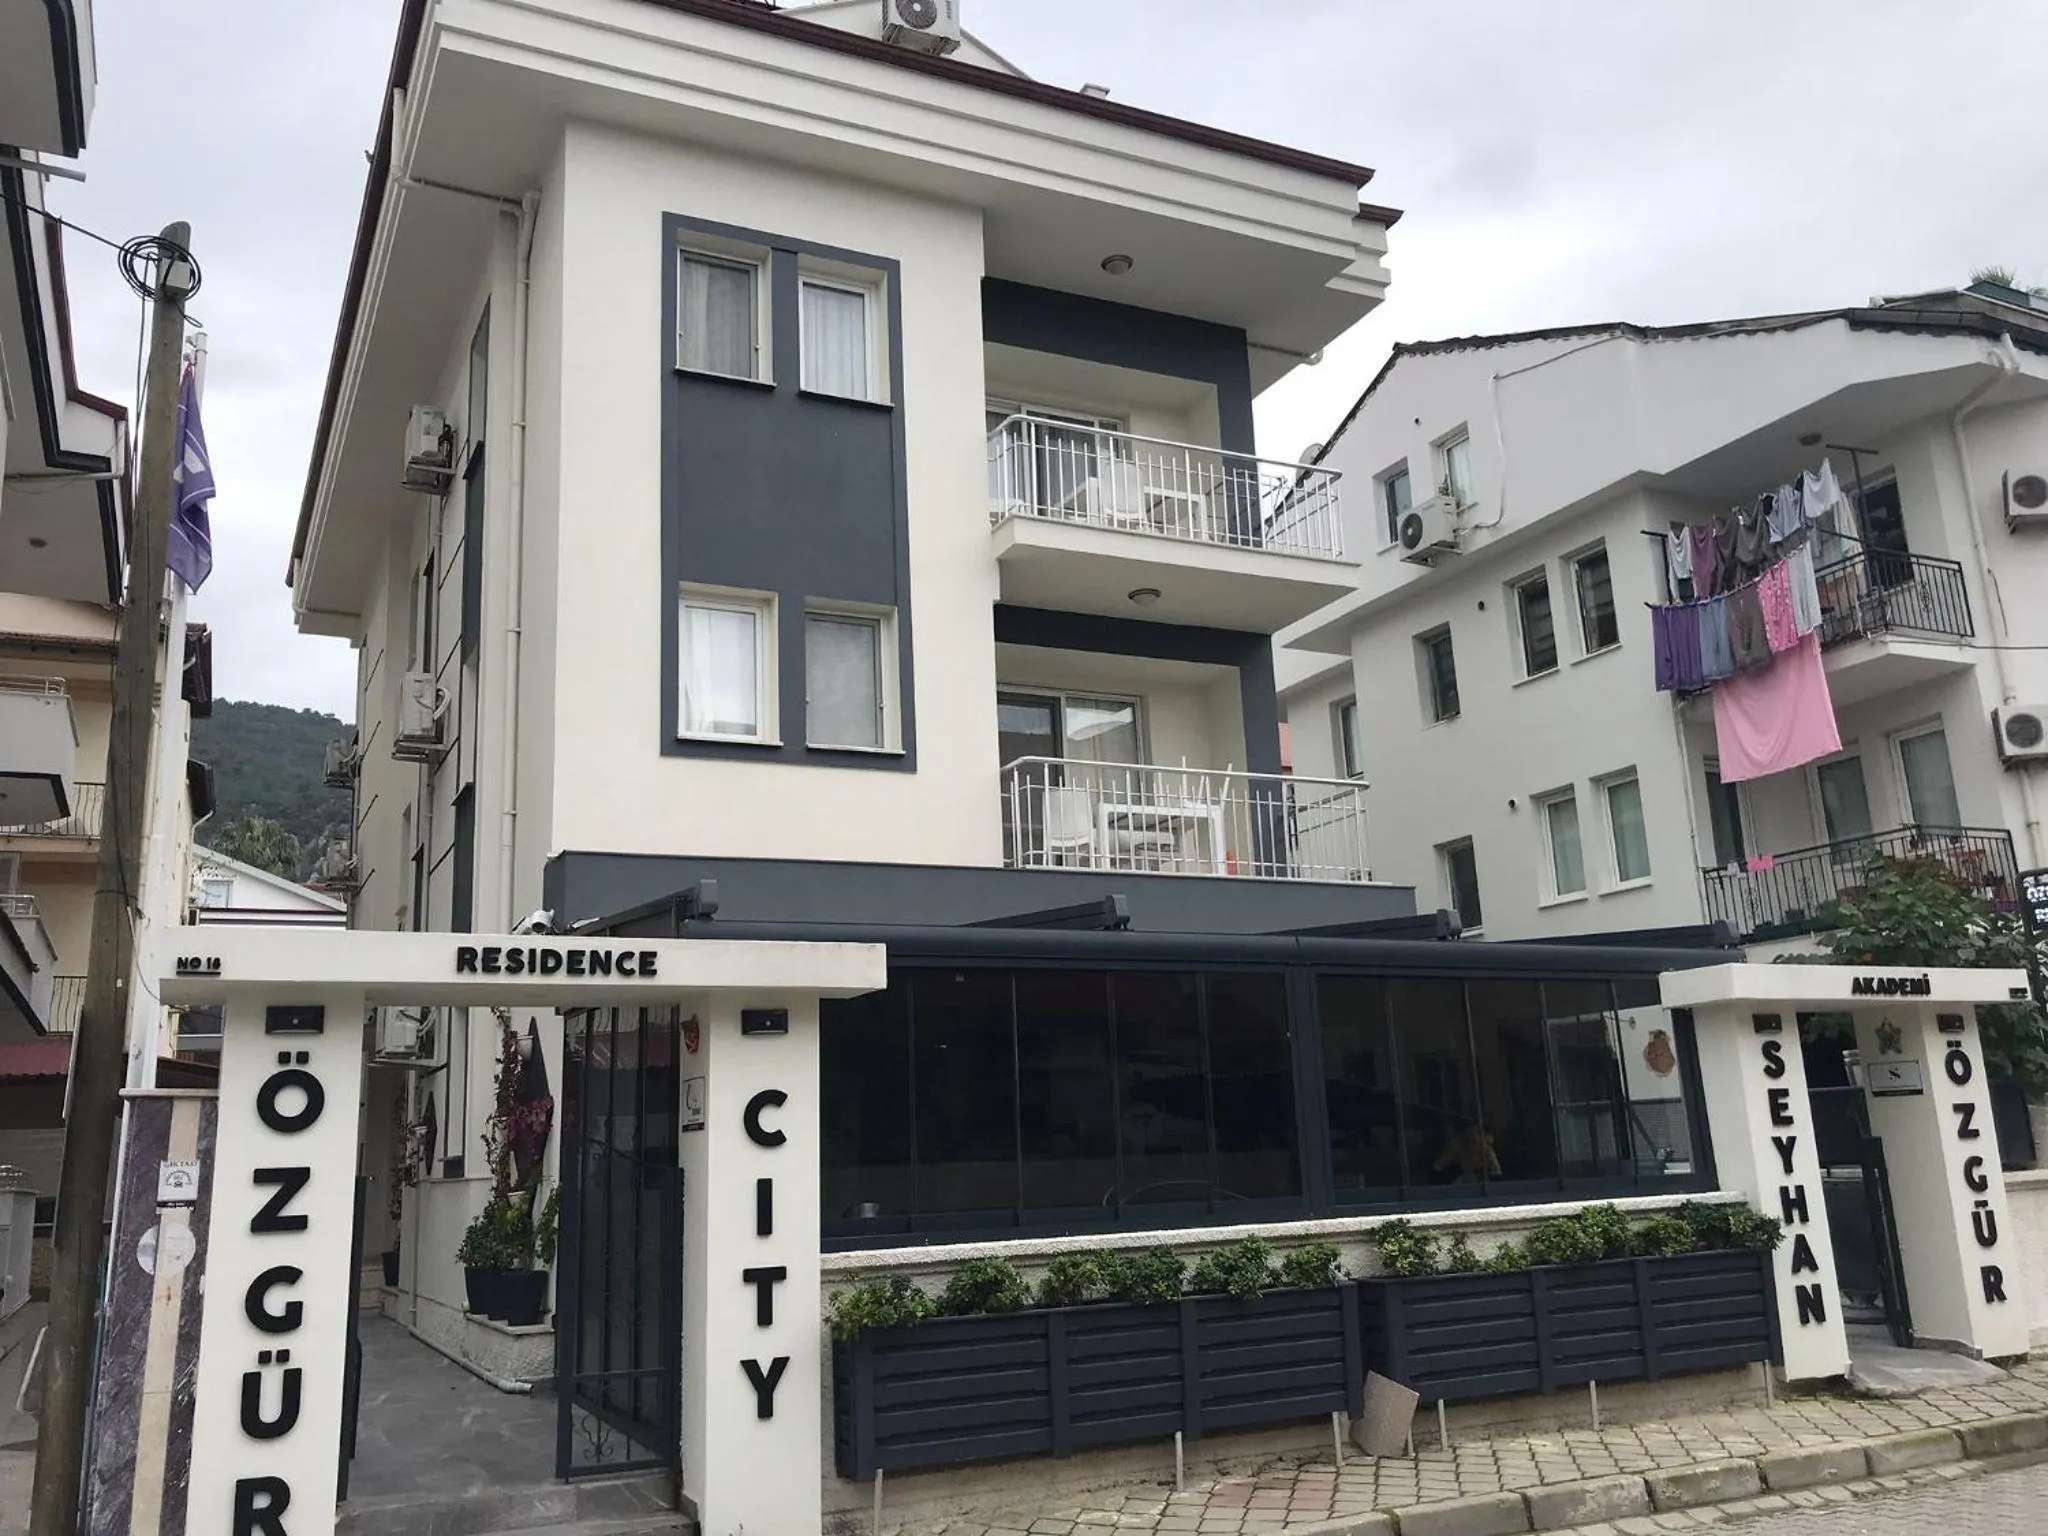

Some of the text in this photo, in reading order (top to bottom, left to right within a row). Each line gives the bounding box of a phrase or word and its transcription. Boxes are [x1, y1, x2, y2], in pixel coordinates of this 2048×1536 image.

[177, 957, 202, 970] NO
[457, 947, 658, 978] RESIDENCE
[1852, 973, 1931, 996] AKADEMİ
[233, 1050, 325, 1536] ÖZGÜR
[740, 1089, 790, 1420] CITY
[1761, 1039, 1827, 1326] SEYHAN
[1944, 1039, 2007, 1304] ÖZGÜR
